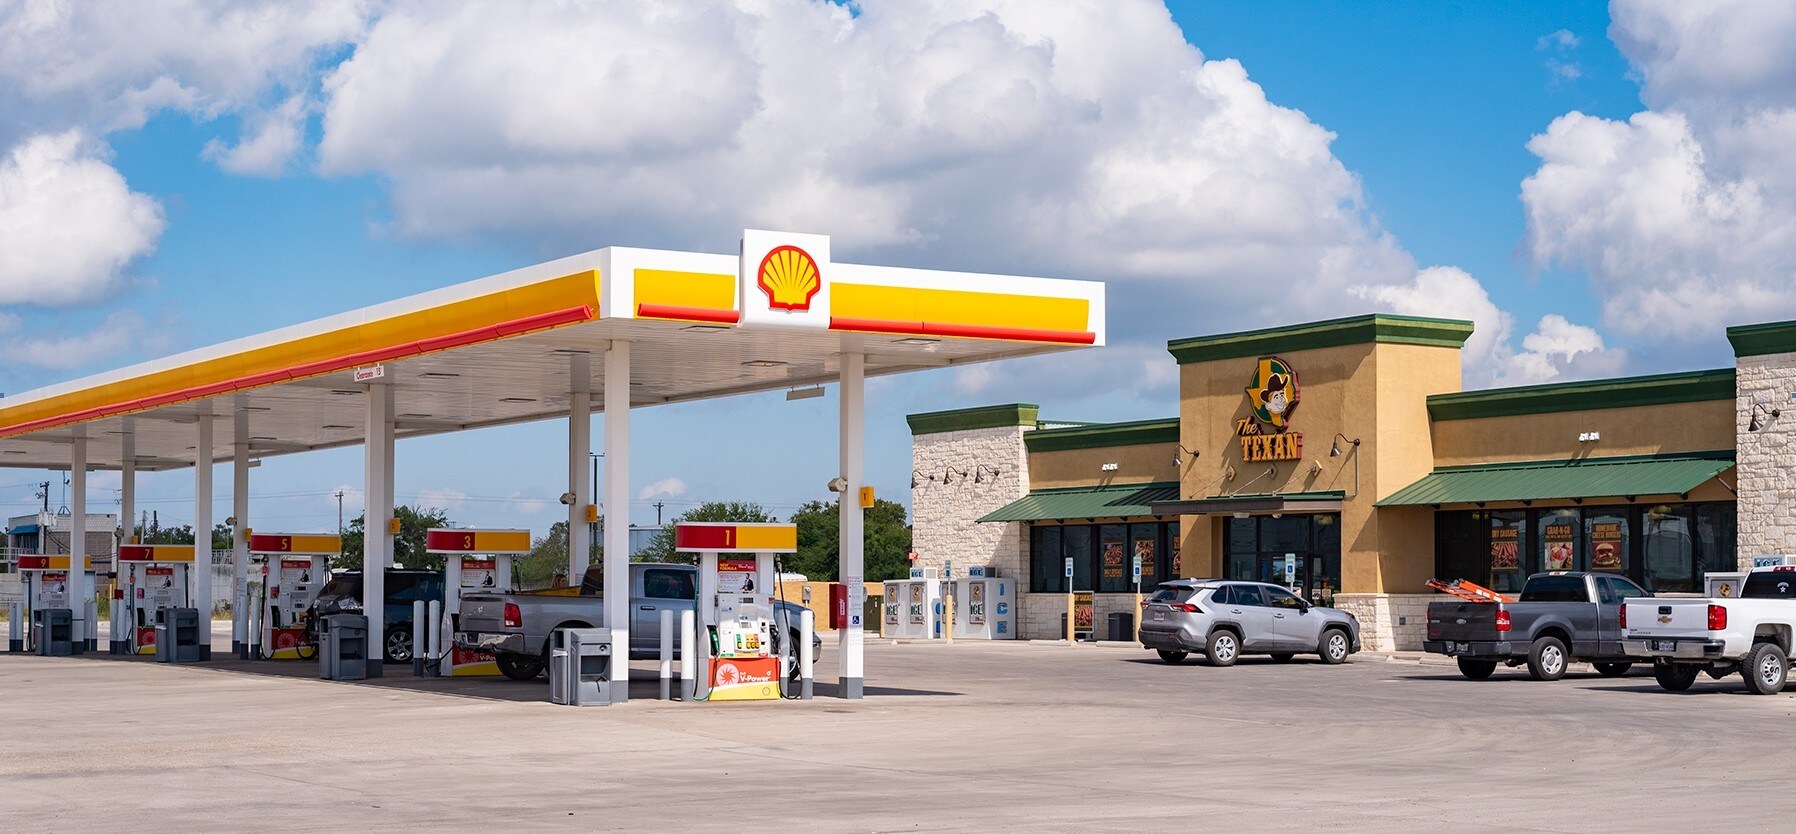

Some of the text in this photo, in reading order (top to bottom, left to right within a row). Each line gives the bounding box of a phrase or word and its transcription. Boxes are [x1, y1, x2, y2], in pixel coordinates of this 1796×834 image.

[1236, 416, 1259, 435] The
[1240, 432, 1300, 461] TEXAN
[463, 535, 472, 549] 3
[725, 529, 731, 546] 1
[281, 538, 288, 550] 5
[144, 548, 151, 560] 7
[40, 558, 47, 568] 9
[911, 569, 923, 578] ICE
[969, 567, 983, 576] ICE
[886, 603, 898, 615] ICE
[911, 603, 922, 615] ICE
[970, 602, 983, 615] ICE
